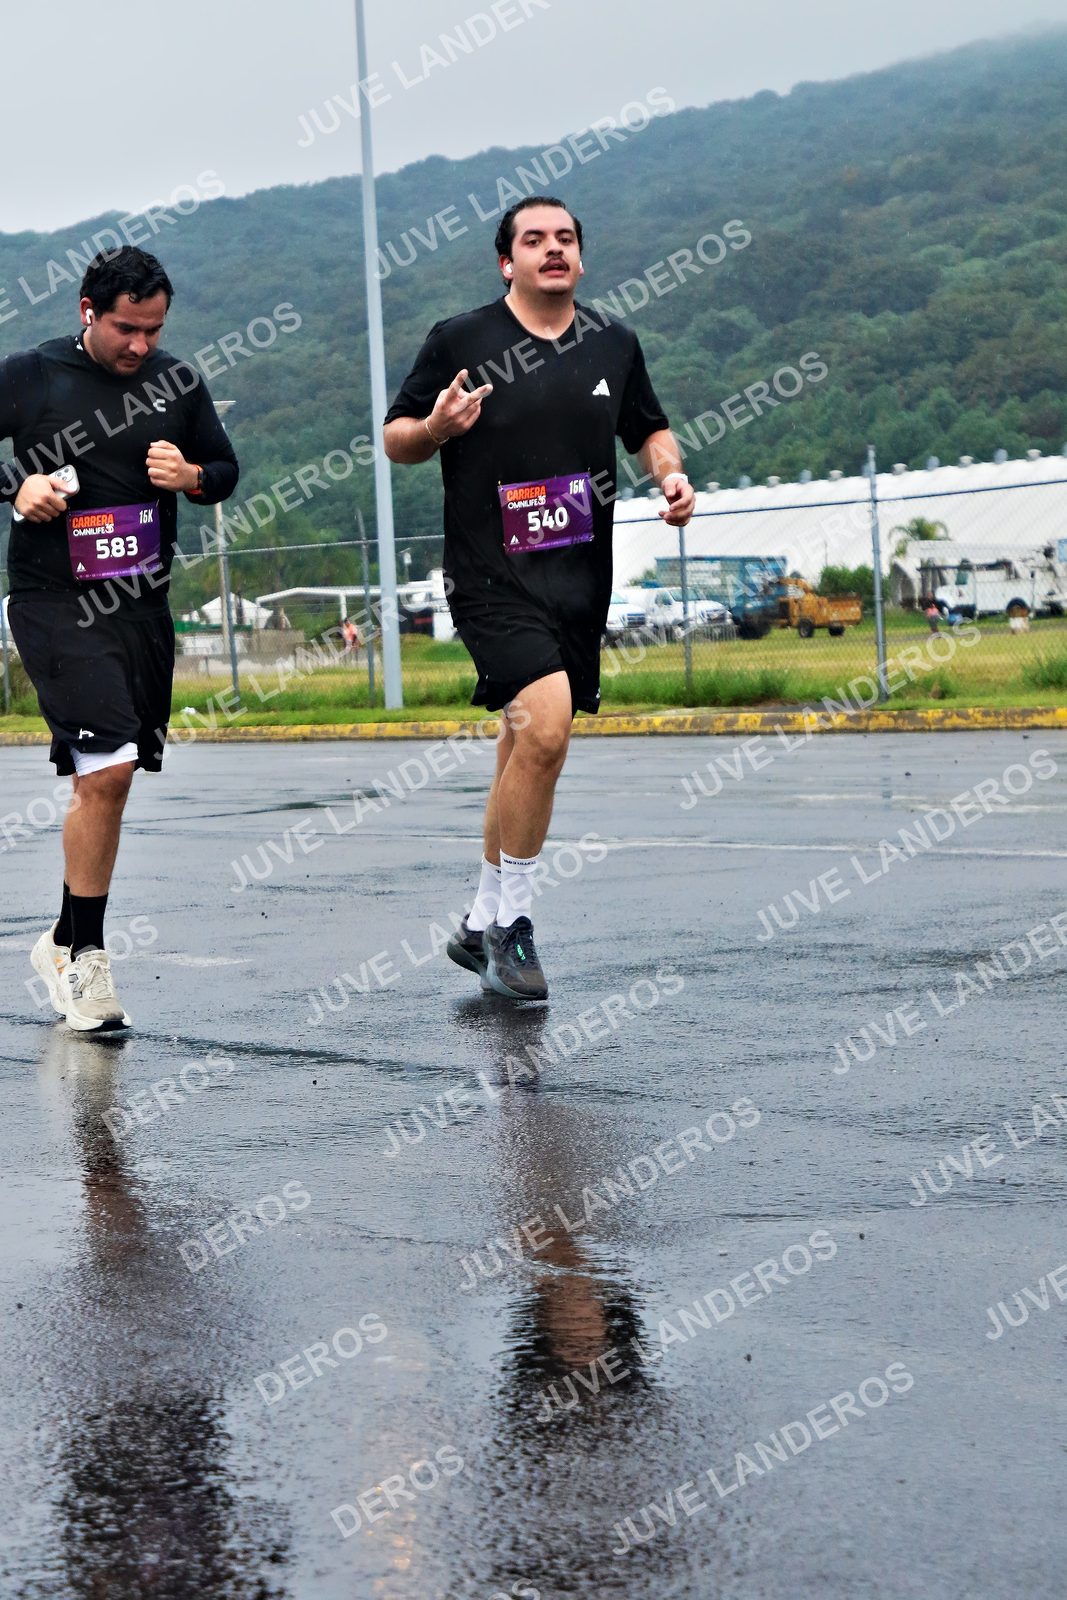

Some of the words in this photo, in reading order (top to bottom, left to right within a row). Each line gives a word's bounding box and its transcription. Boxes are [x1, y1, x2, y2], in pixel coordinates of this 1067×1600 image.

[506, 486, 546, 501] CARRERA
[72, 514, 114, 528] CARRERA
[527, 506, 568, 532] 540
[95, 535, 139, 559] 583
